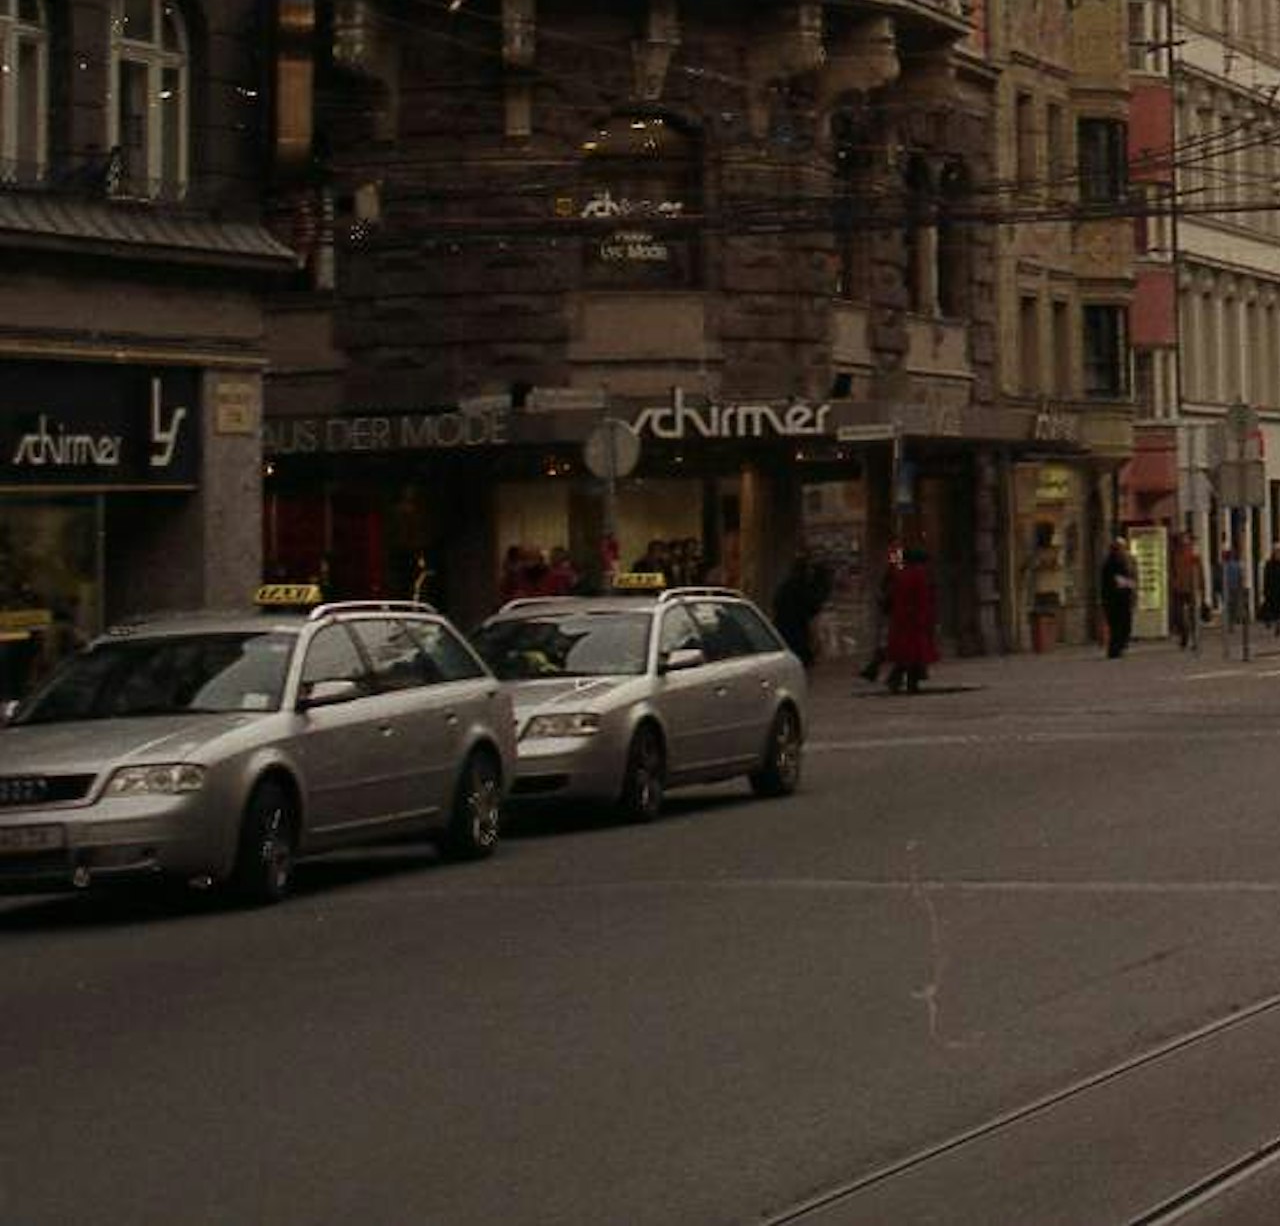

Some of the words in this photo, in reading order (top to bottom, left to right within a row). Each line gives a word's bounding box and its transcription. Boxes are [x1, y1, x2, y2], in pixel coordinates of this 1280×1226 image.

[328, 415, 390, 450] DER
[401, 408, 511, 447] MODE
[631, 387, 829, 436] schirmer
[13, 414, 122, 464] schirmer
